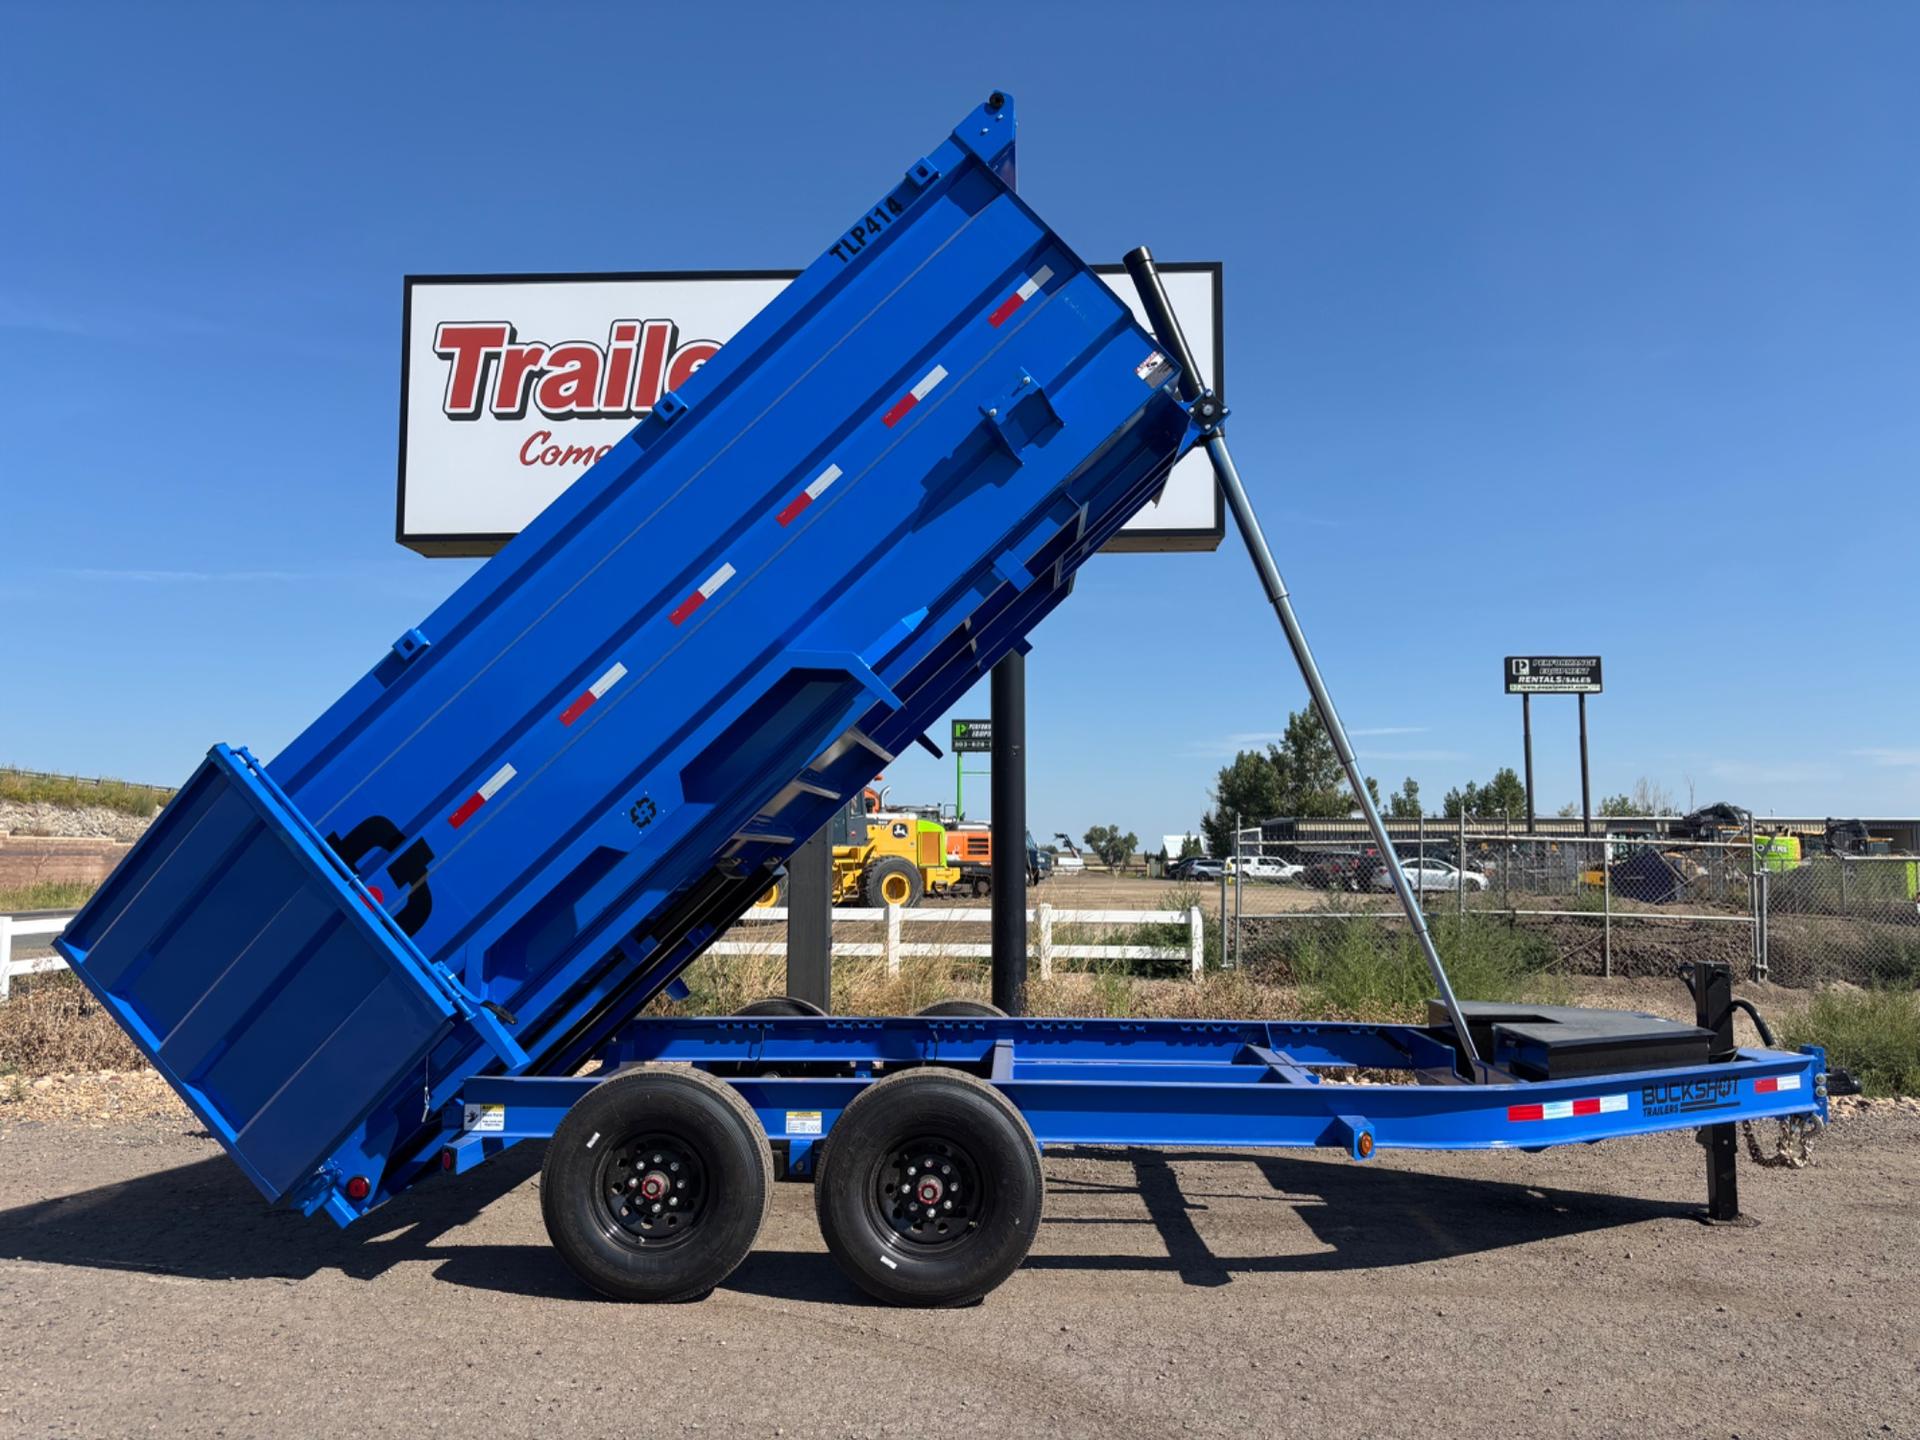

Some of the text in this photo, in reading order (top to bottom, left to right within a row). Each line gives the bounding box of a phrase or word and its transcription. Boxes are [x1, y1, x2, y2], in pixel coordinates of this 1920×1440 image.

[829, 196, 903, 262] TLP414
[1642, 1075, 1740, 1105] BUCKSHOT
[1643, 1103, 1679, 1117] TRAILERS
